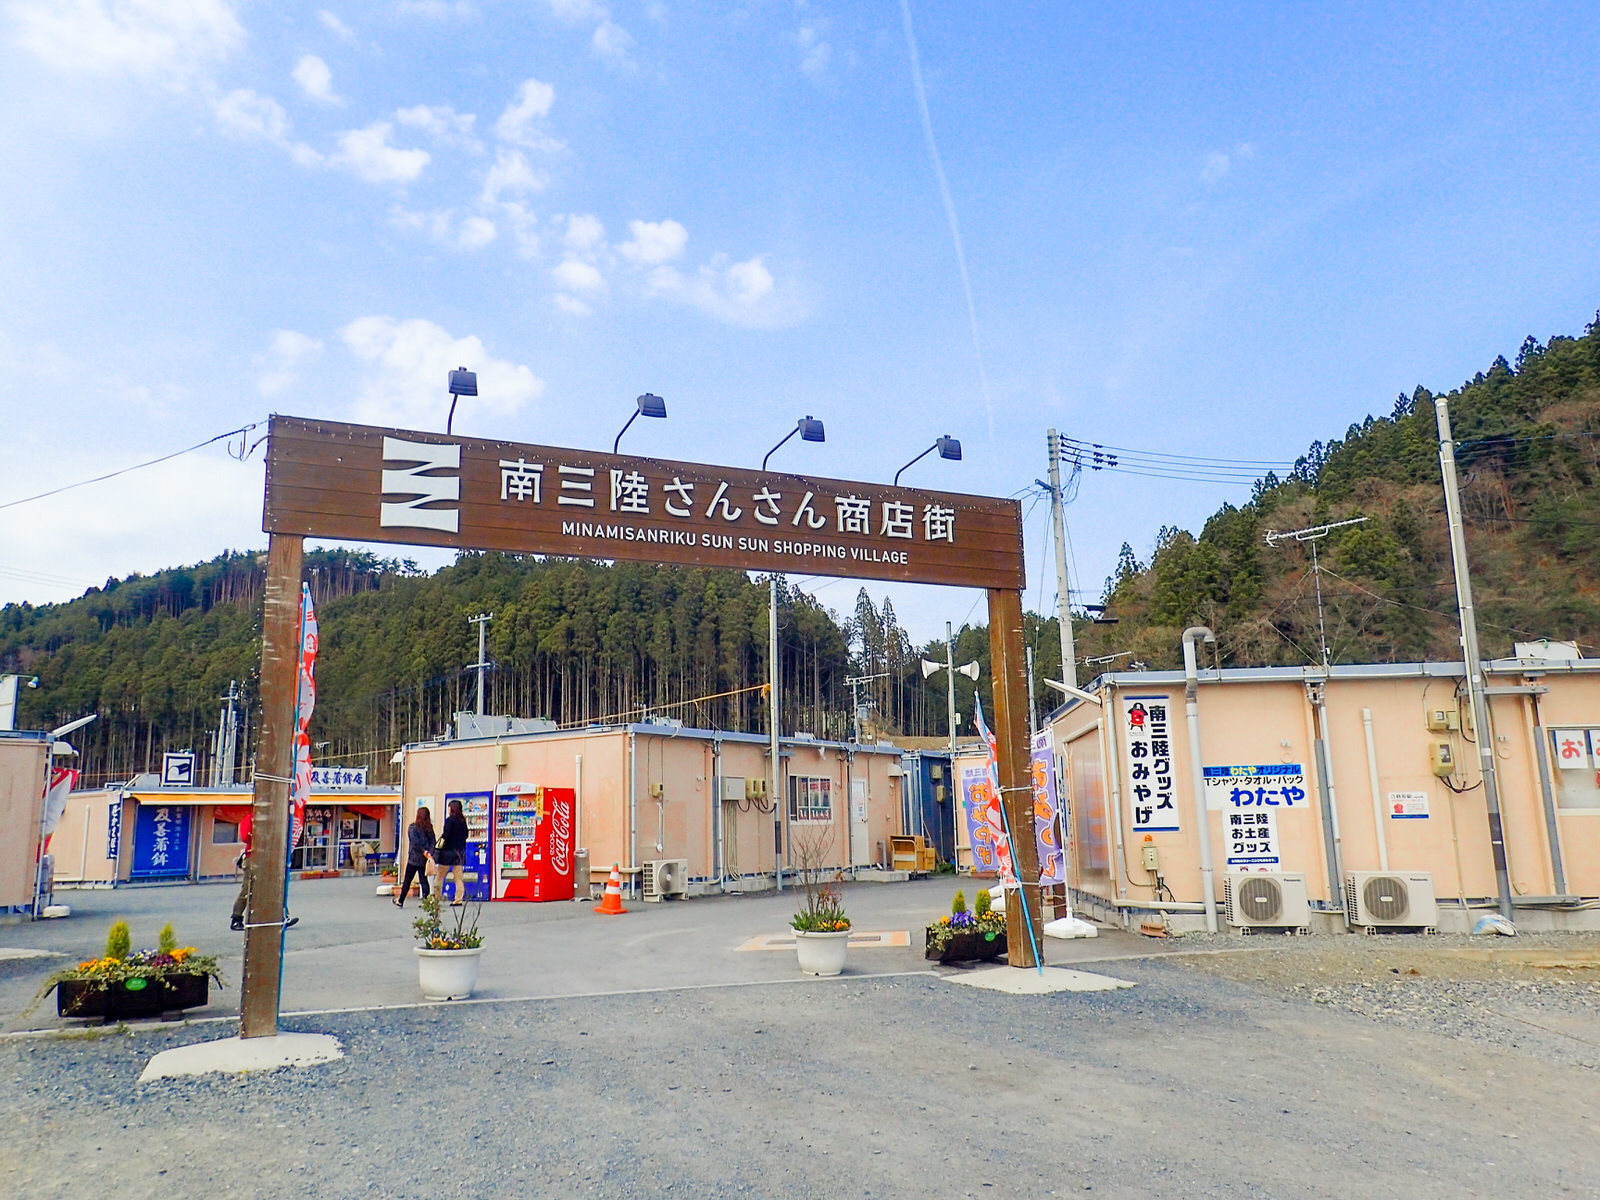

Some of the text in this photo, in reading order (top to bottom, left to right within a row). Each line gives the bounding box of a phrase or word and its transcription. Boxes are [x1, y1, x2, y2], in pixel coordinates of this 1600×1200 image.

[498, 457, 956, 544] 南三陸さんさん商店街
[562, 520, 909, 566] MINAMISANRIKU SUN SUN SHOPPING VILLAGE
[1148, 705, 1174, 810] 南三陸グッズ
[1561, 738, 1584, 760] お
[1130, 740, 1154, 825] おみやげ
[1204, 775, 1304, 786] Tシャツ・タオル・バッグ
[1230, 785, 1305, 807] わたや
[1229, 813, 1269, 826] 南三陸
[1231, 827, 1271, 840] お土産
[1232, 842, 1272, 854] グッズ
